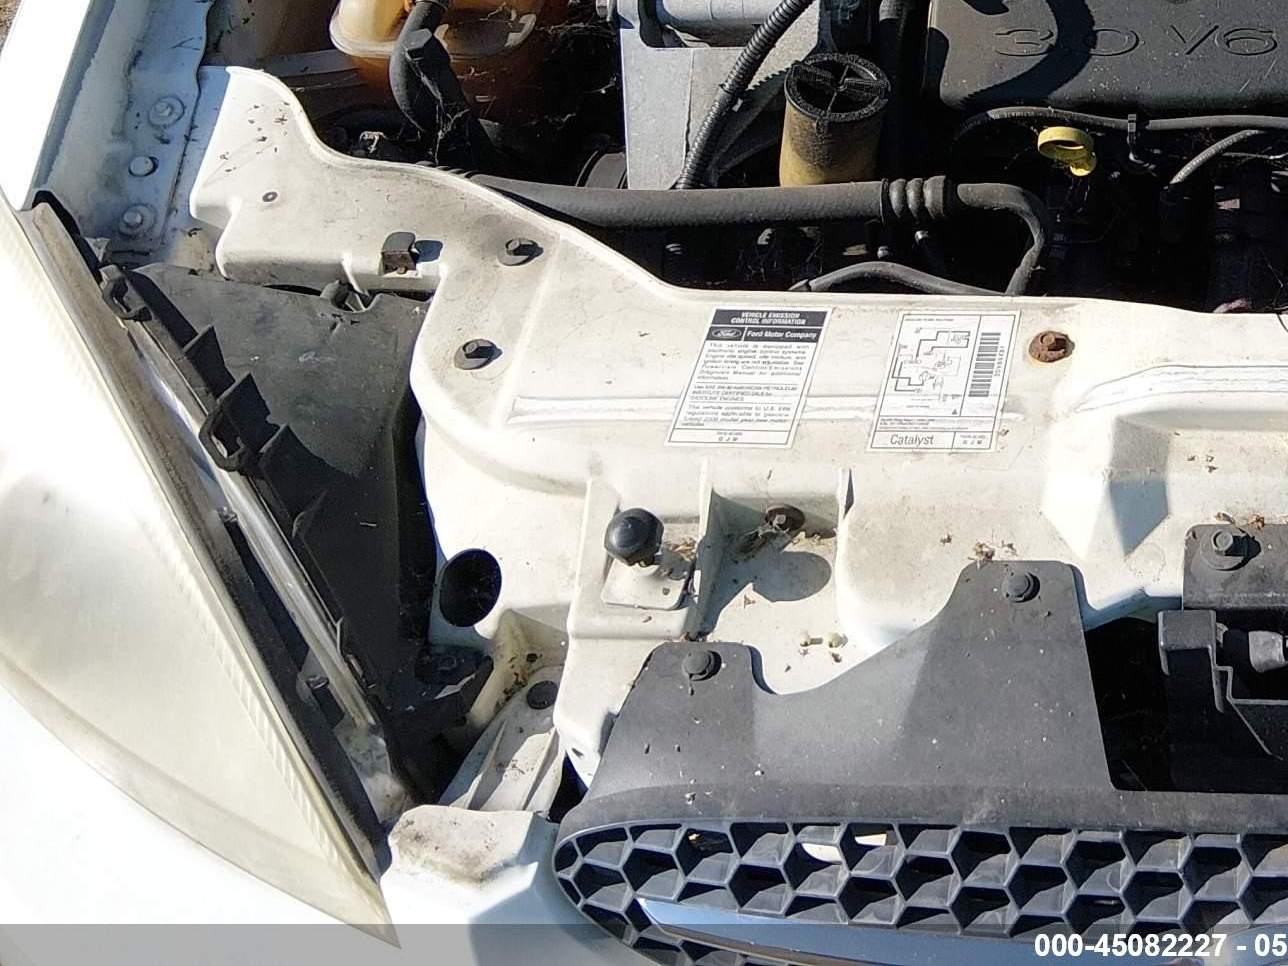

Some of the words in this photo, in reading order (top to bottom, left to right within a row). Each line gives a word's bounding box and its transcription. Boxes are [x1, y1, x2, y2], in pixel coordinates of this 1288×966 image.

[1170, 24, 1278, 56] V6
[785, 331, 817, 339] Company
[890, 434, 934, 446] Catalyst
